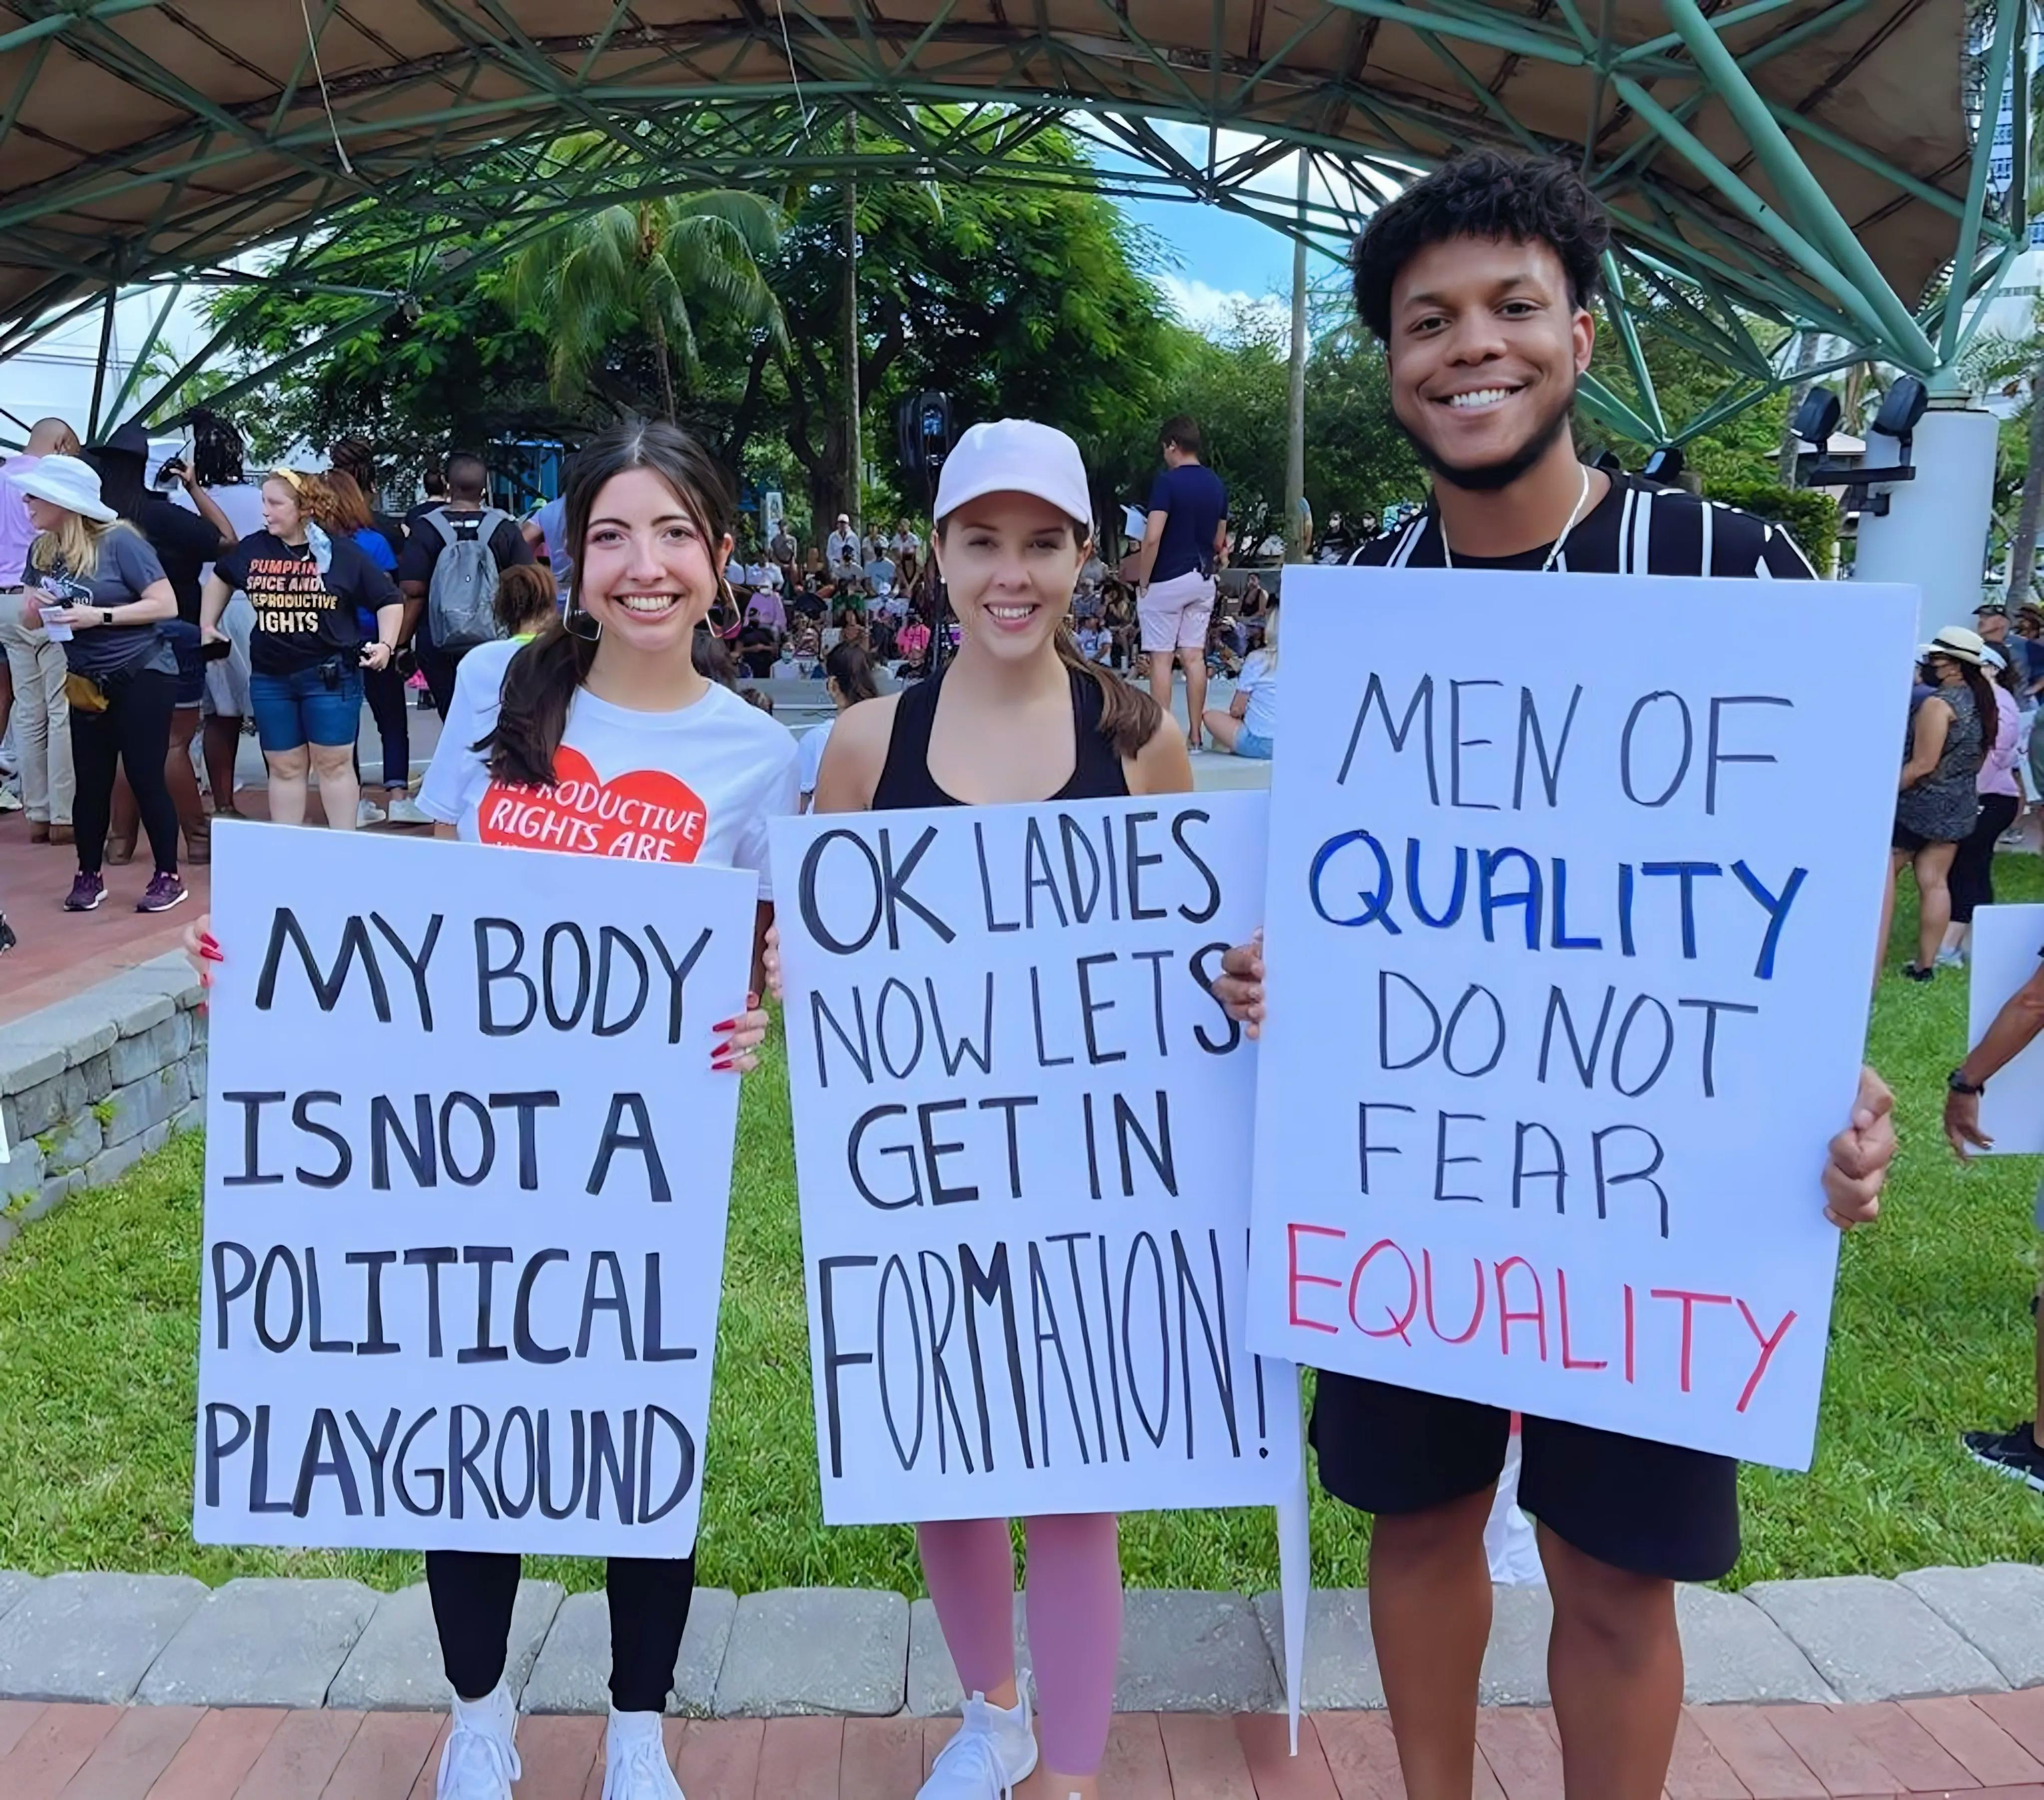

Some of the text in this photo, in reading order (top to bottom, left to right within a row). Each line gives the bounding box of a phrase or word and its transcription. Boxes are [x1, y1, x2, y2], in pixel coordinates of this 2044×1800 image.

[247, 576, 320, 592] SPICE AND
[249, 592, 338, 610] EPRODUCTIVE
[258, 611, 318, 633] IGHTS
[1337, 672, 1794, 815] MEN OF
[488, 797, 676, 862] RIGHTS ARE
[494, 779, 703, 840] ODUCTIVE
[798, 809, 1221, 955] OK LADIES
[1309, 829, 1808, 979] QUALITY
[255, 907, 713, 1045] MY BODY
[810, 942, 1241, 1088] NOW LETS
[1379, 969, 1759, 1098] DO NOT
[223, 1090, 673, 1202] IS NOT A
[847, 1090, 1179, 1210] GET IN
[1359, 1101, 1669, 1239] FEAR
[212, 1241, 698, 1364] POLITICAL
[818, 1227, 1269, 1478] FORMATION!
[1286, 1222, 1798, 1413] EQUALITY
[205, 1402, 695, 1525] PLAYGROUND
